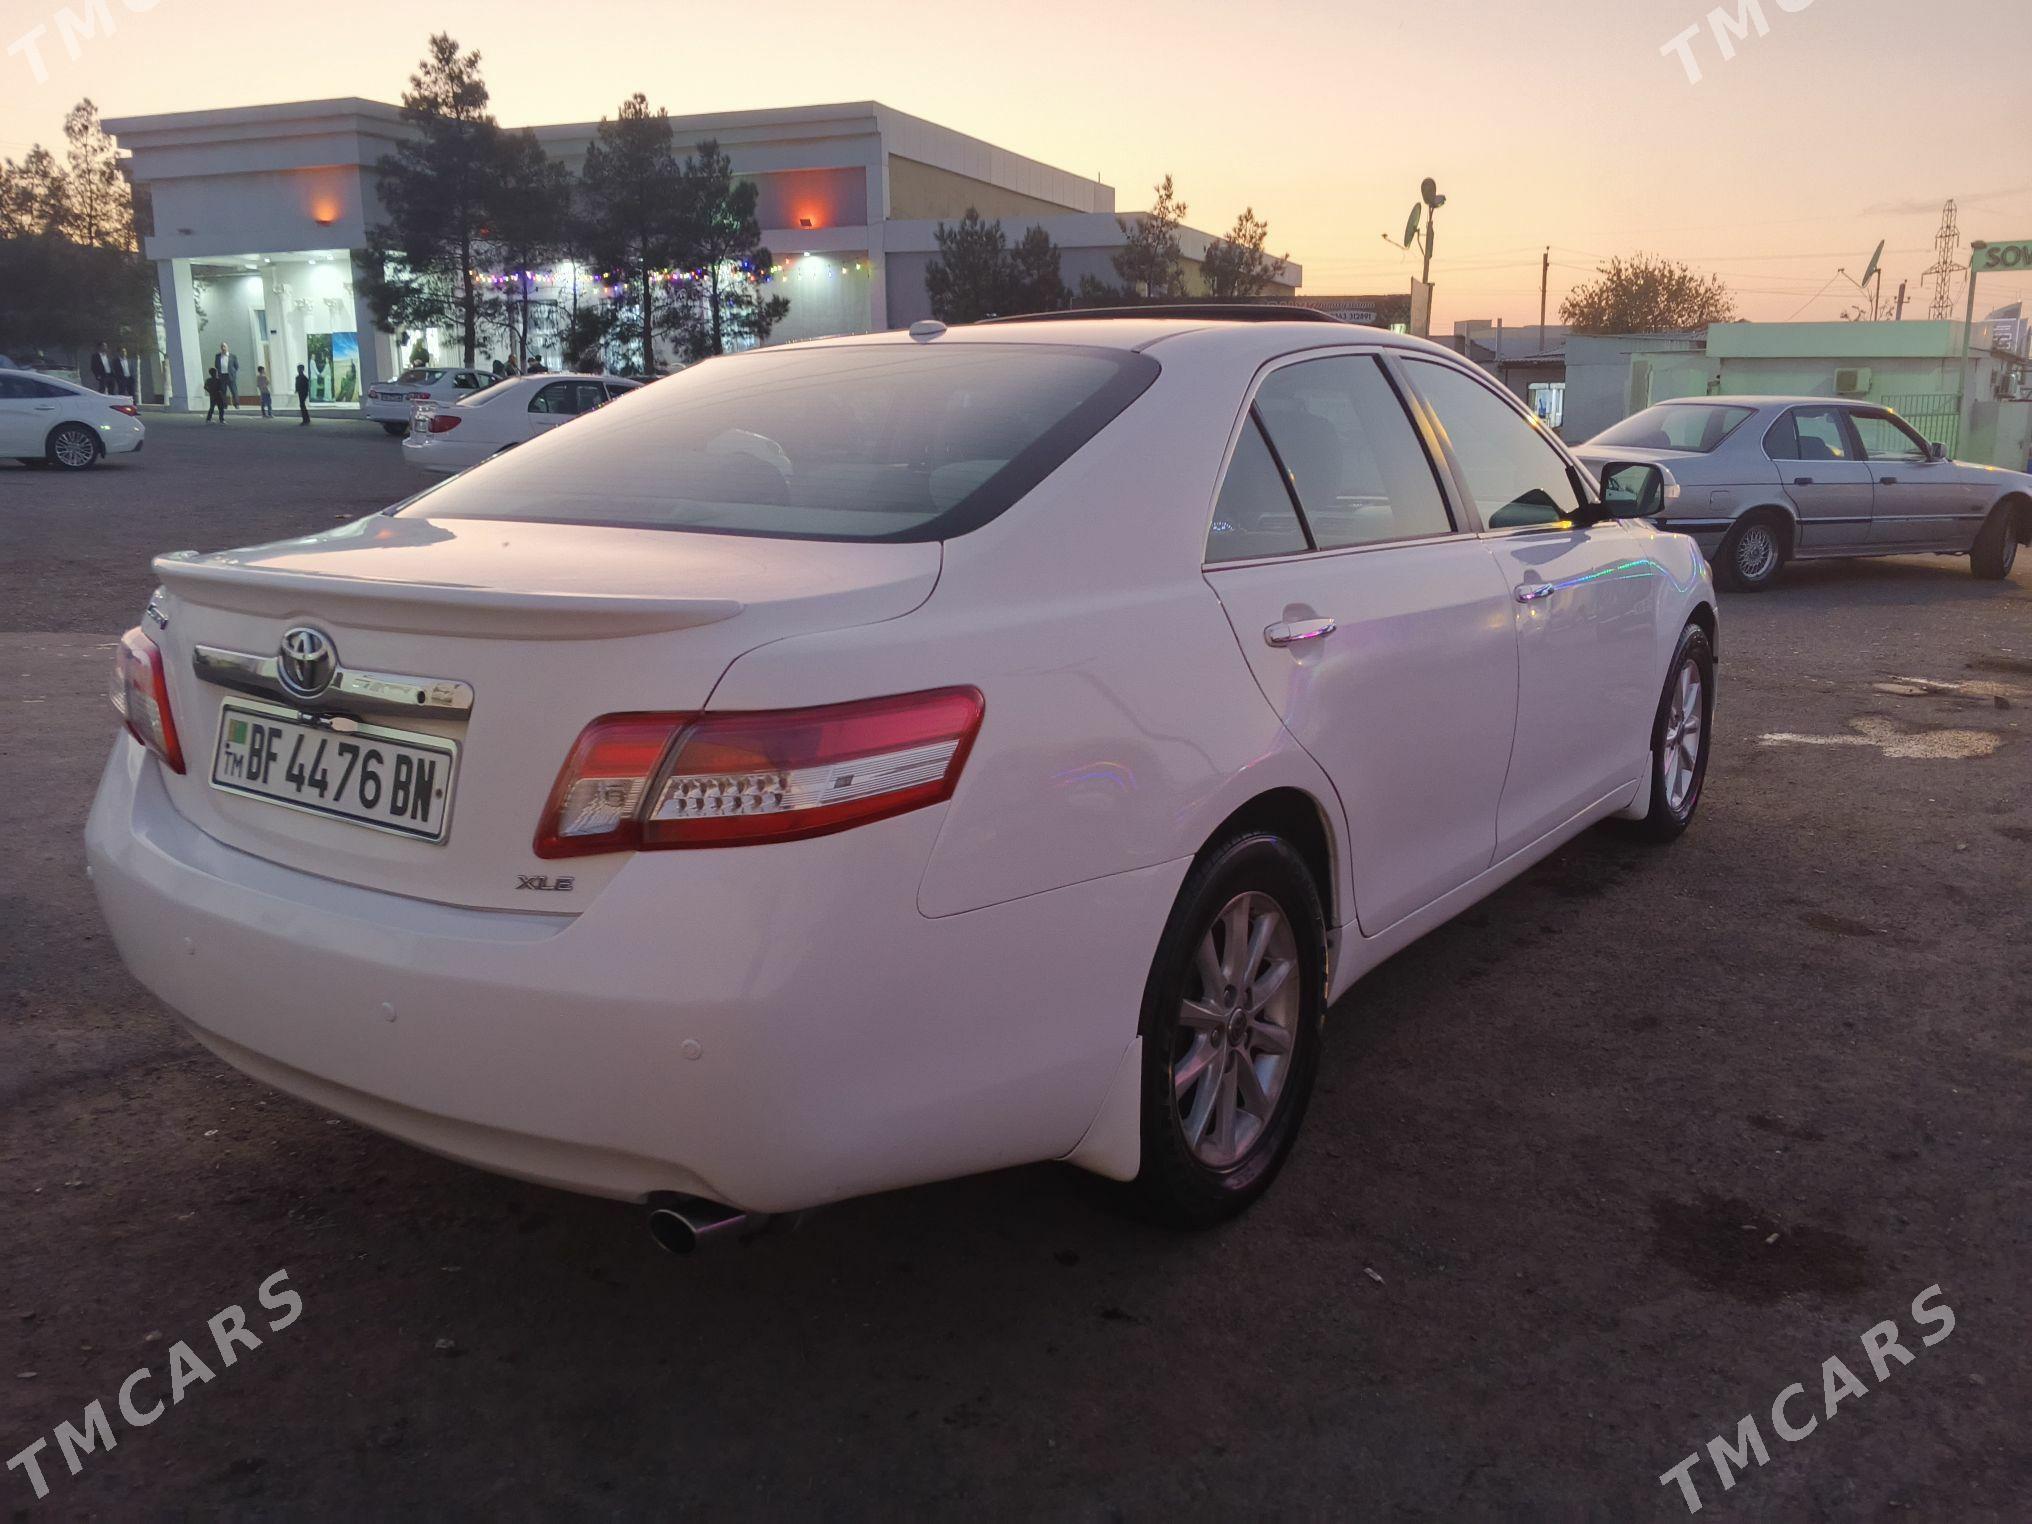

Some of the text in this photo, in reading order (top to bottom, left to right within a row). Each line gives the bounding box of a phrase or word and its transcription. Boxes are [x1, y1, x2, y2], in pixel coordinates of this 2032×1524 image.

[224, 751, 244, 778] TM
[246, 723, 436, 823] BF 4476 BN
[515, 874, 575, 892] XLE
